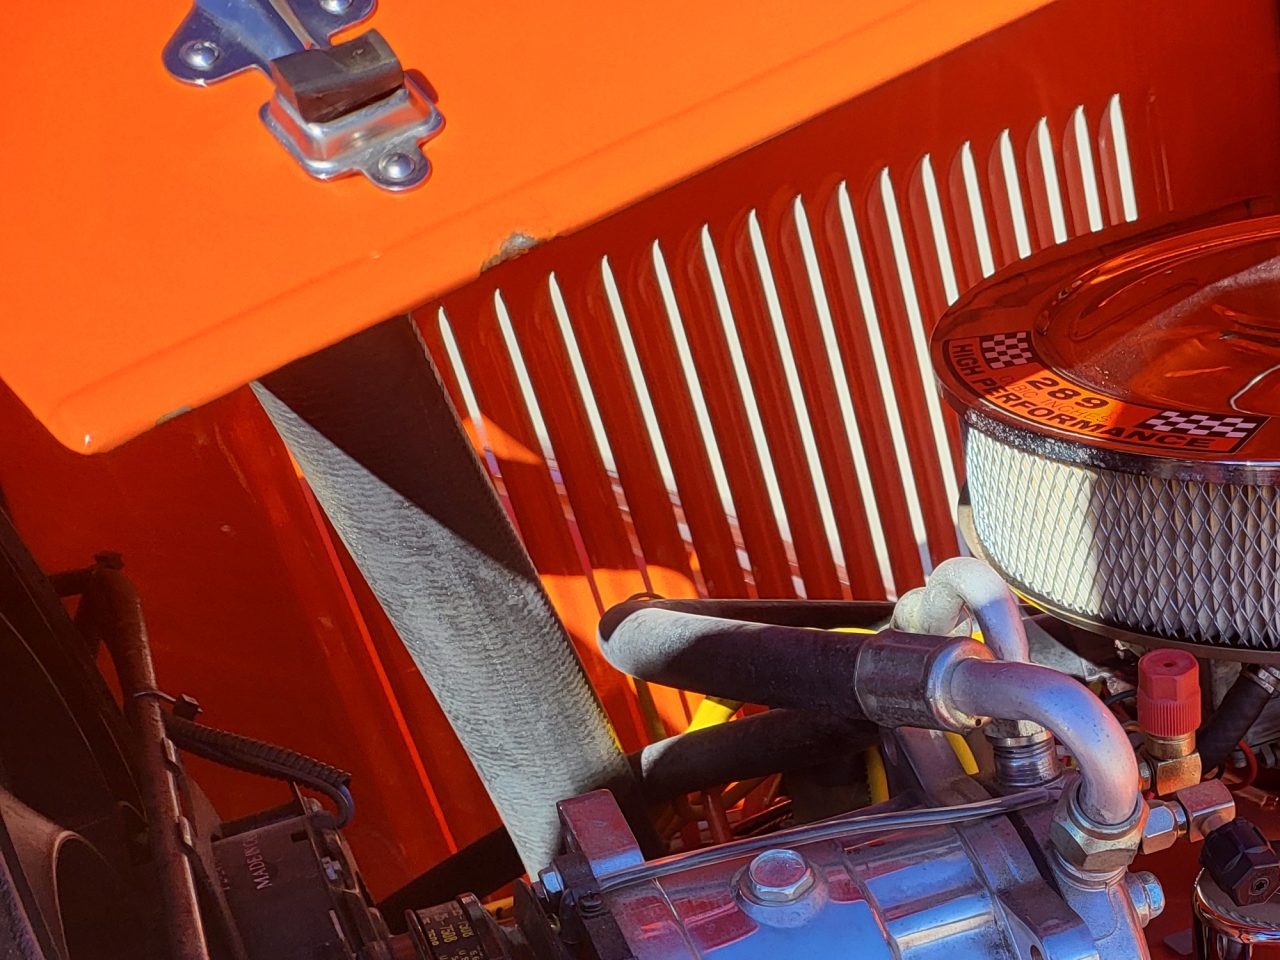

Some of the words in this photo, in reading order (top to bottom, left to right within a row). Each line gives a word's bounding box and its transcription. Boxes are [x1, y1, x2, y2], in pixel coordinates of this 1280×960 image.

[951, 343, 986, 377] HIGH
[970, 377, 1214, 449] PERFORMANCE
[1025, 377, 1110, 409] 289
[1040, 399, 1113, 424] INCHES
[246, 854, 272, 890] MADE
